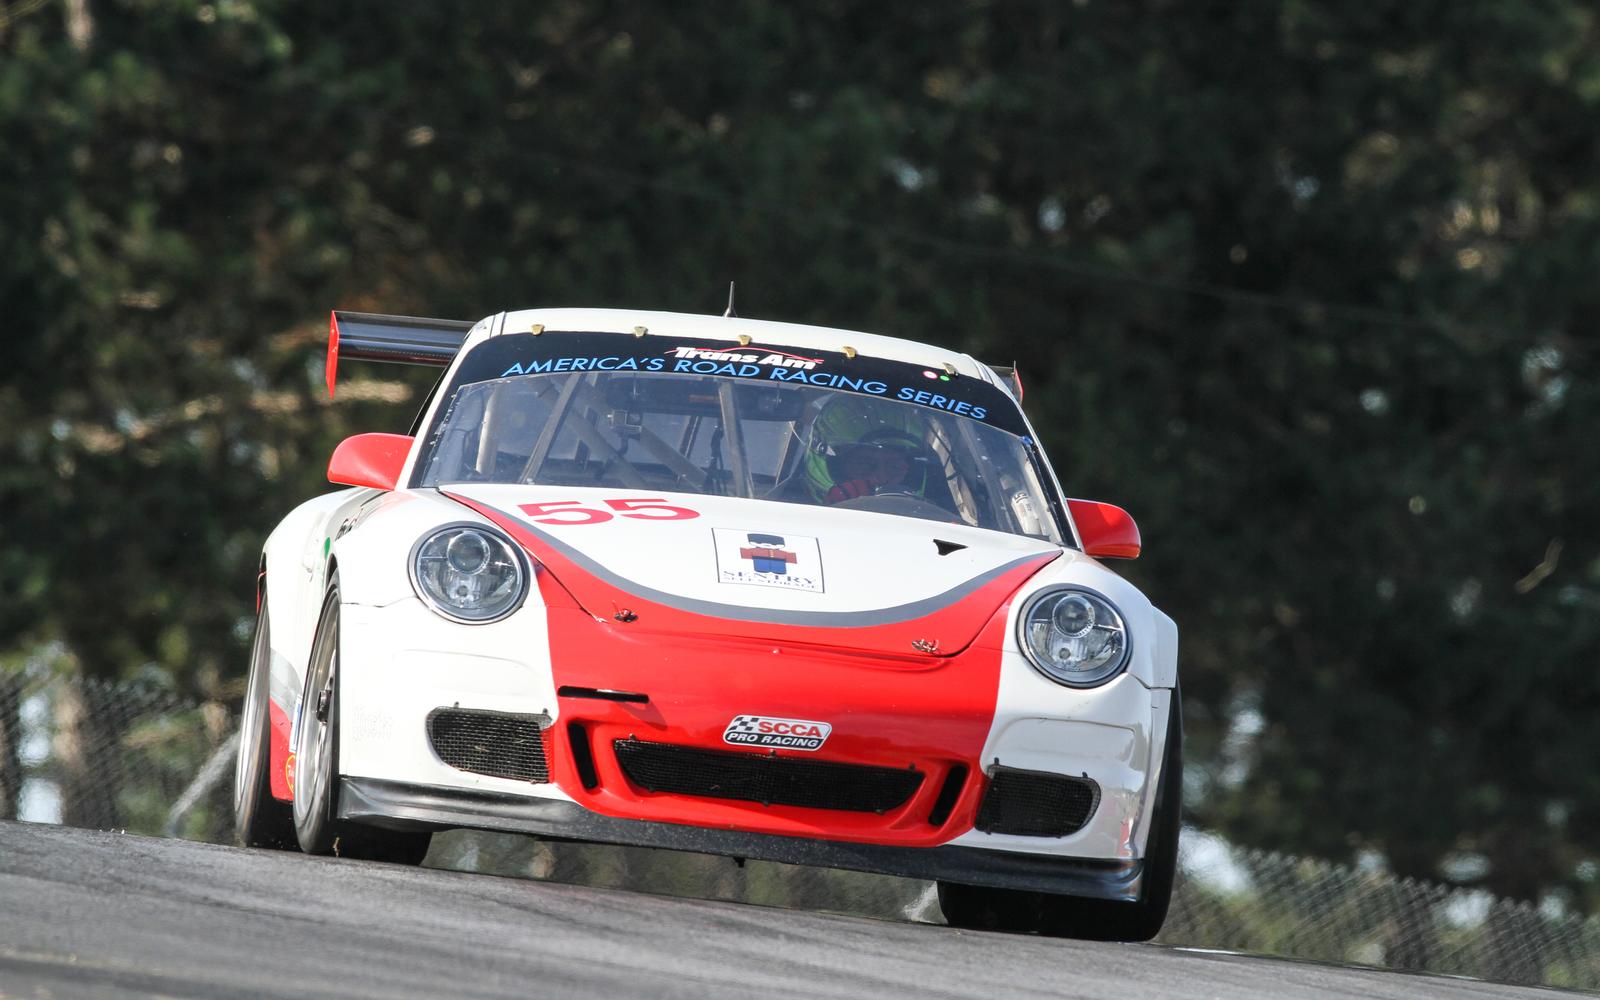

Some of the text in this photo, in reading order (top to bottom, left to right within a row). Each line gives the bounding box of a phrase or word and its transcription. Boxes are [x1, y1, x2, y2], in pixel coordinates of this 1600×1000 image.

[674, 347, 817, 370] Trans Am
[501, 355, 987, 419] AMERICA'S ROAD RACING SERIES
[517, 498, 701, 526] 55
[727, 732, 820, 748] PRO RACING
[758, 721, 823, 738] SCCA
